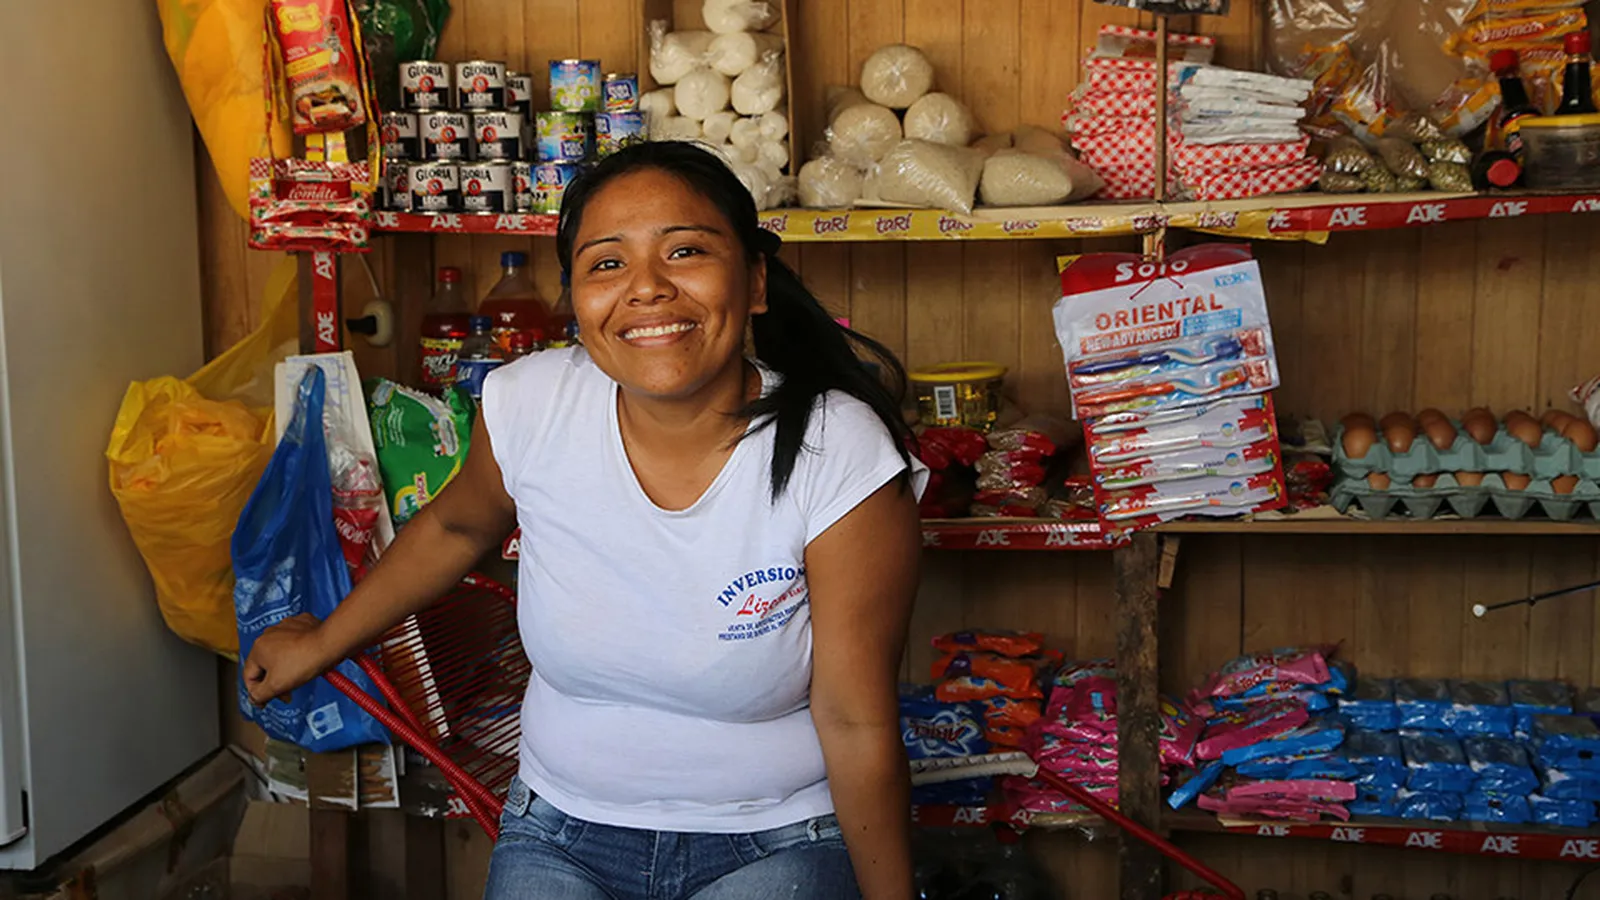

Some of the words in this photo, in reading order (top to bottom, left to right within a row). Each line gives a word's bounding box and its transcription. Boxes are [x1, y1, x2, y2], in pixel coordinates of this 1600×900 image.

[408, 66, 443, 79] GLORIA
[463, 65, 497, 79] GLORIA
[429, 117, 465, 129] GLORIA
[416, 168, 453, 182] GLORIA
[431, 213, 462, 228] AJE
[496, 213, 528, 230] AJE
[1328, 206, 1367, 226] AJE
[1406, 203, 1446, 224] AJE
[1096, 293, 1224, 330] ORIENTAL
[317, 311, 335, 344] AJE
[975, 529, 1011, 545] AJE
[1045, 531, 1082, 546] AJE
[953, 806, 987, 823] AJE
[1331, 828, 1365, 842] AJE
[1406, 832, 1442, 848] AJE
[1481, 836, 1520, 853] AJE
[1560, 840, 1600, 858] AJE
